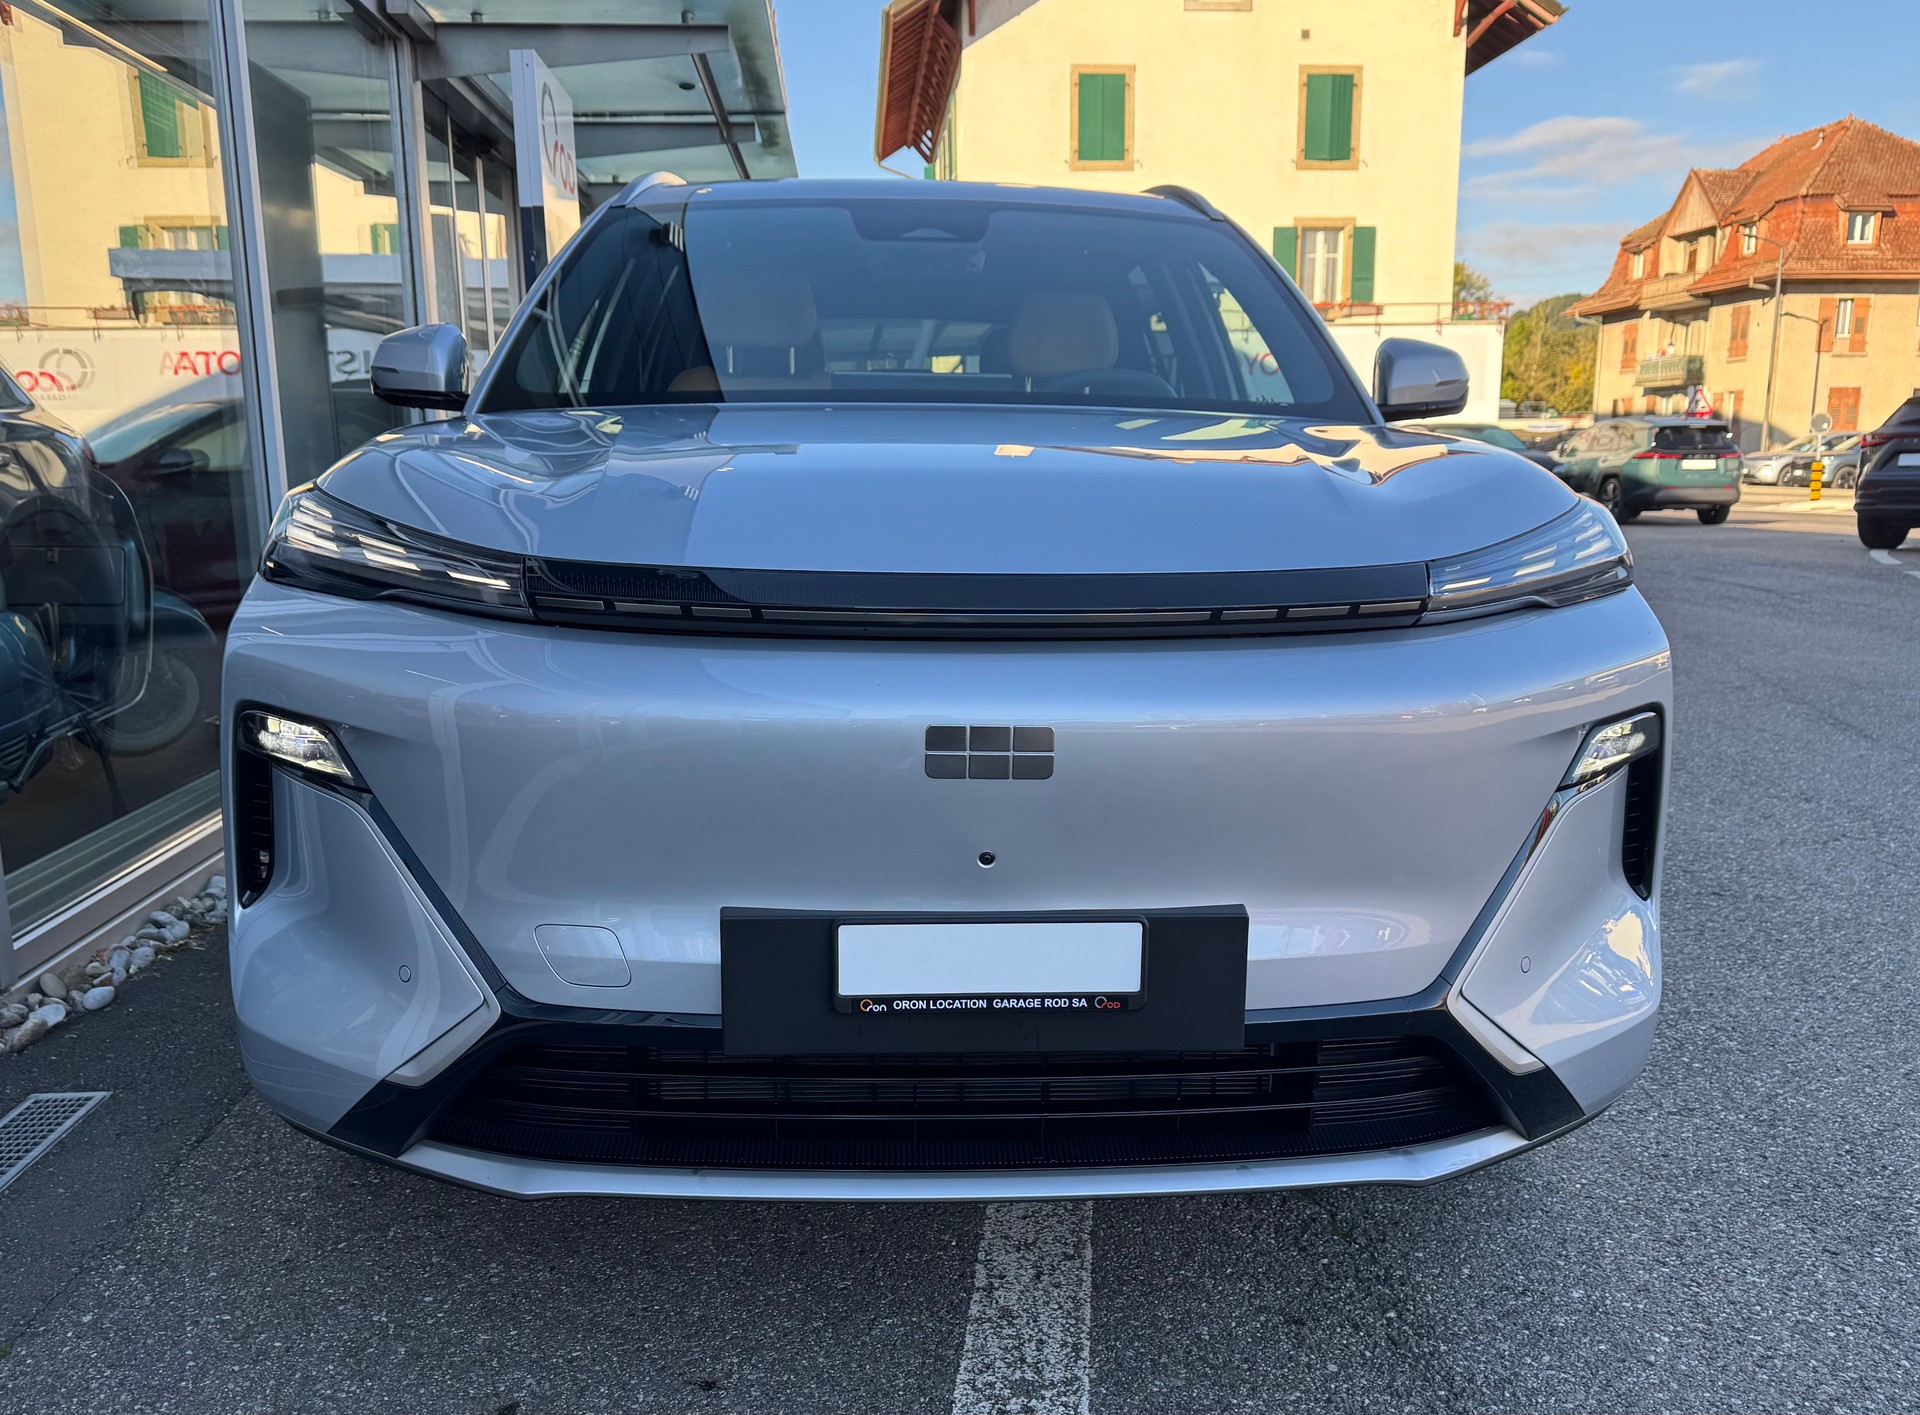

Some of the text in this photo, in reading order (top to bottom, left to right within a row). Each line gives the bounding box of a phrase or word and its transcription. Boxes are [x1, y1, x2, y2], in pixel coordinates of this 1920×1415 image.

[893, 1000, 927, 1010] ORON
[929, 999, 987, 1009] LOCATION
[992, 998, 1042, 1009] GARAGE
[1044, 998, 1069, 1008] ROD
[1071, 998, 1088, 1008] SA
